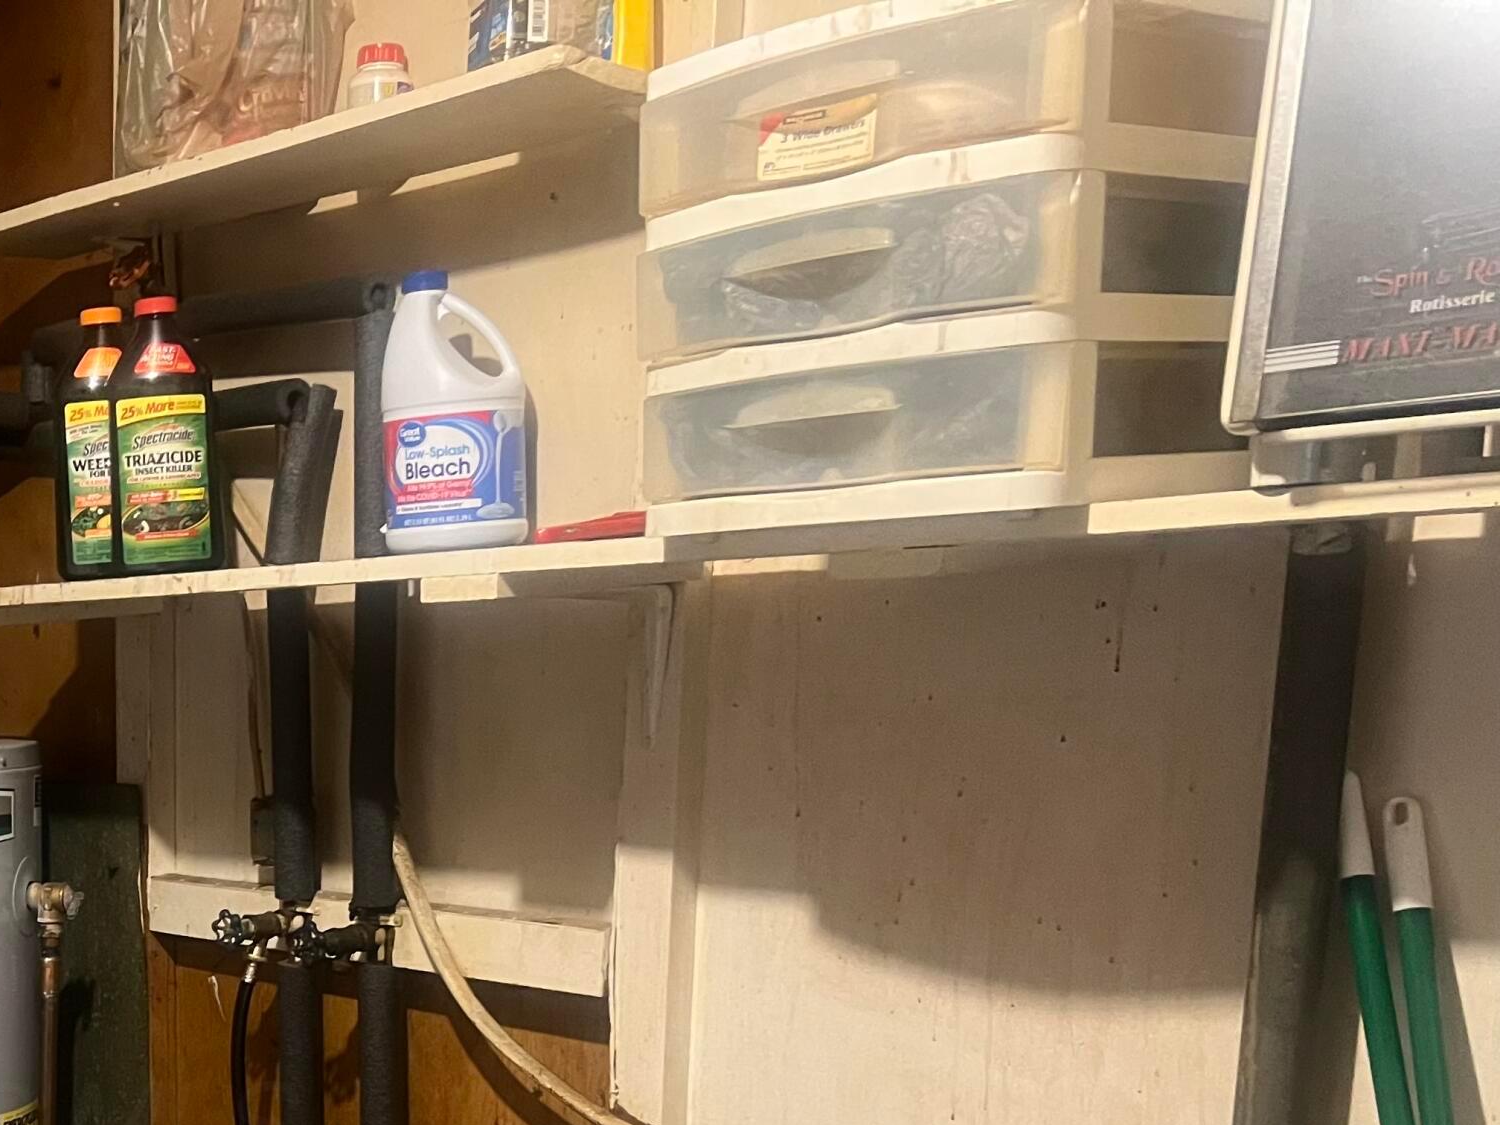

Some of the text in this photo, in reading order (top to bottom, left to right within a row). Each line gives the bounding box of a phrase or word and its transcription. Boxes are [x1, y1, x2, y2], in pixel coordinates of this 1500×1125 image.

[1408, 289, 1496, 314] Rotisserie
[144, 400, 175, 415] More
[132, 429, 195, 451] Spectracide
[125, 450, 203, 468] TRIAZICIDE
[405, 444, 470, 460] Low-Splash
[135, 464, 193, 477] INSECT KILLER
[405, 458, 471, 480] Bleach
